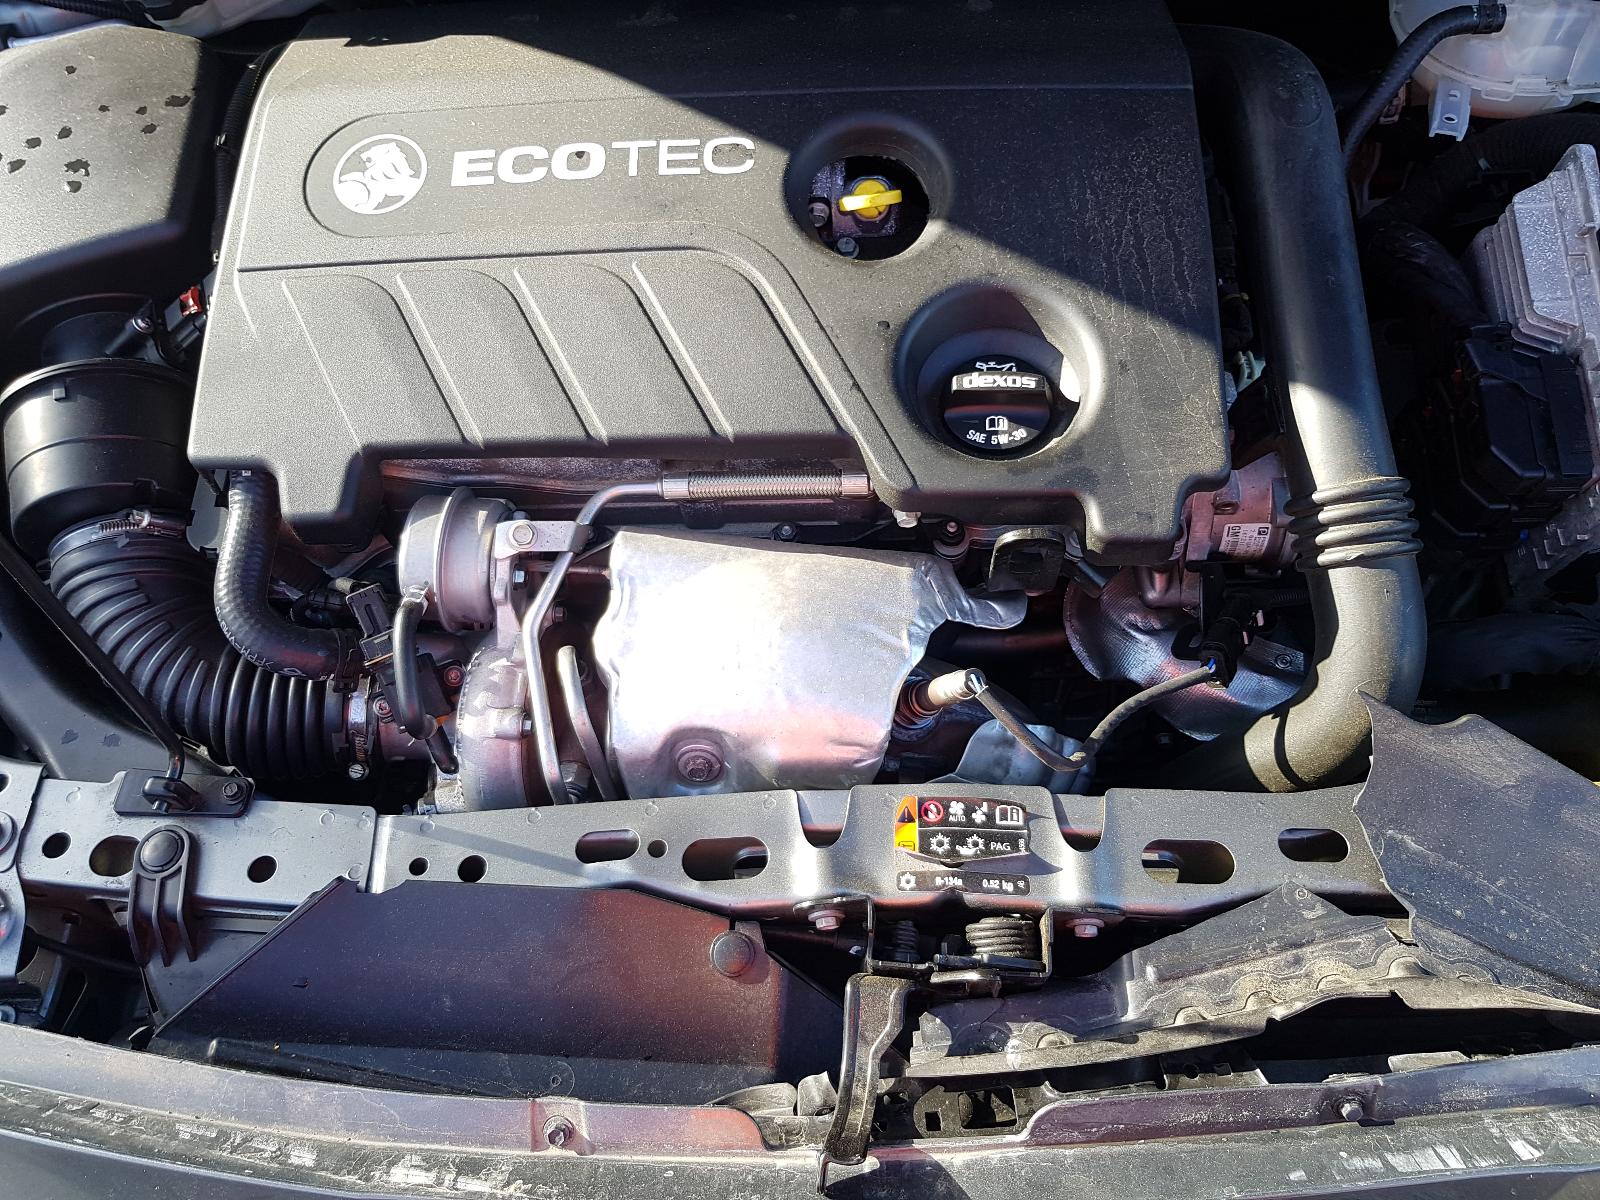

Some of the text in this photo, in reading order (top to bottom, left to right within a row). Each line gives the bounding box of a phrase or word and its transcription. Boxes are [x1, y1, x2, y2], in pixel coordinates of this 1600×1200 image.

[450, 136, 756, 187] ECOTEC
[962, 371, 1038, 389] dexos
[966, 428, 1028, 445] SAE 5W-30
[949, 814, 966, 822] AUTO
[990, 841, 1011, 851] PAG
[935, 876, 1014, 892] R-134a 0.52 kg
